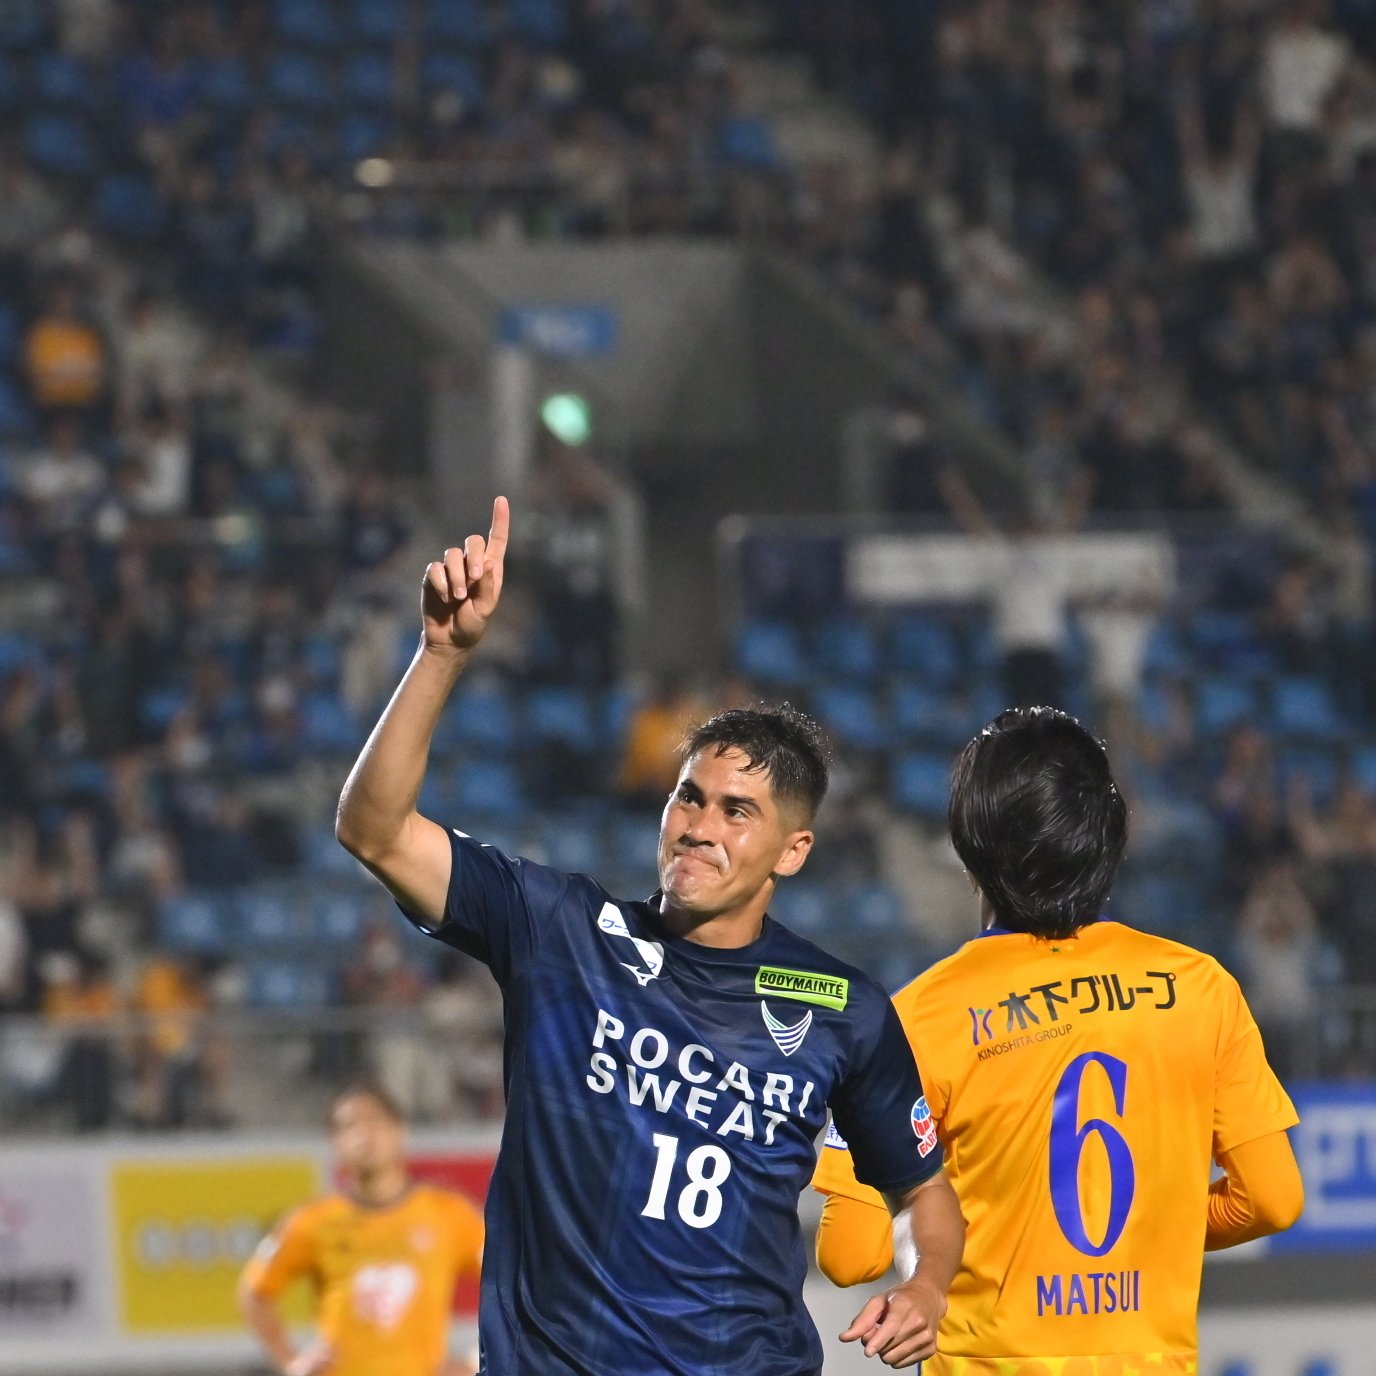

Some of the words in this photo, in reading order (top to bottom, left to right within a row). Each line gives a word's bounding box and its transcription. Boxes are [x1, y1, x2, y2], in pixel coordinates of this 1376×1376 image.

[759, 972, 844, 996] BODYMAINTÉ
[998, 971, 1176, 1033] 木下グループ
[592, 1008, 814, 1118] POCARI
[977, 1035, 1034, 1061] KINOSHITA
[1035, 1023, 1073, 1043] GROUP
[586, 1052, 788, 1146] SWEAT
[641, 1132, 731, 1229] 18
[1049, 1051, 1135, 1257] 6
[1036, 1270, 1139, 1316] MATSUI
